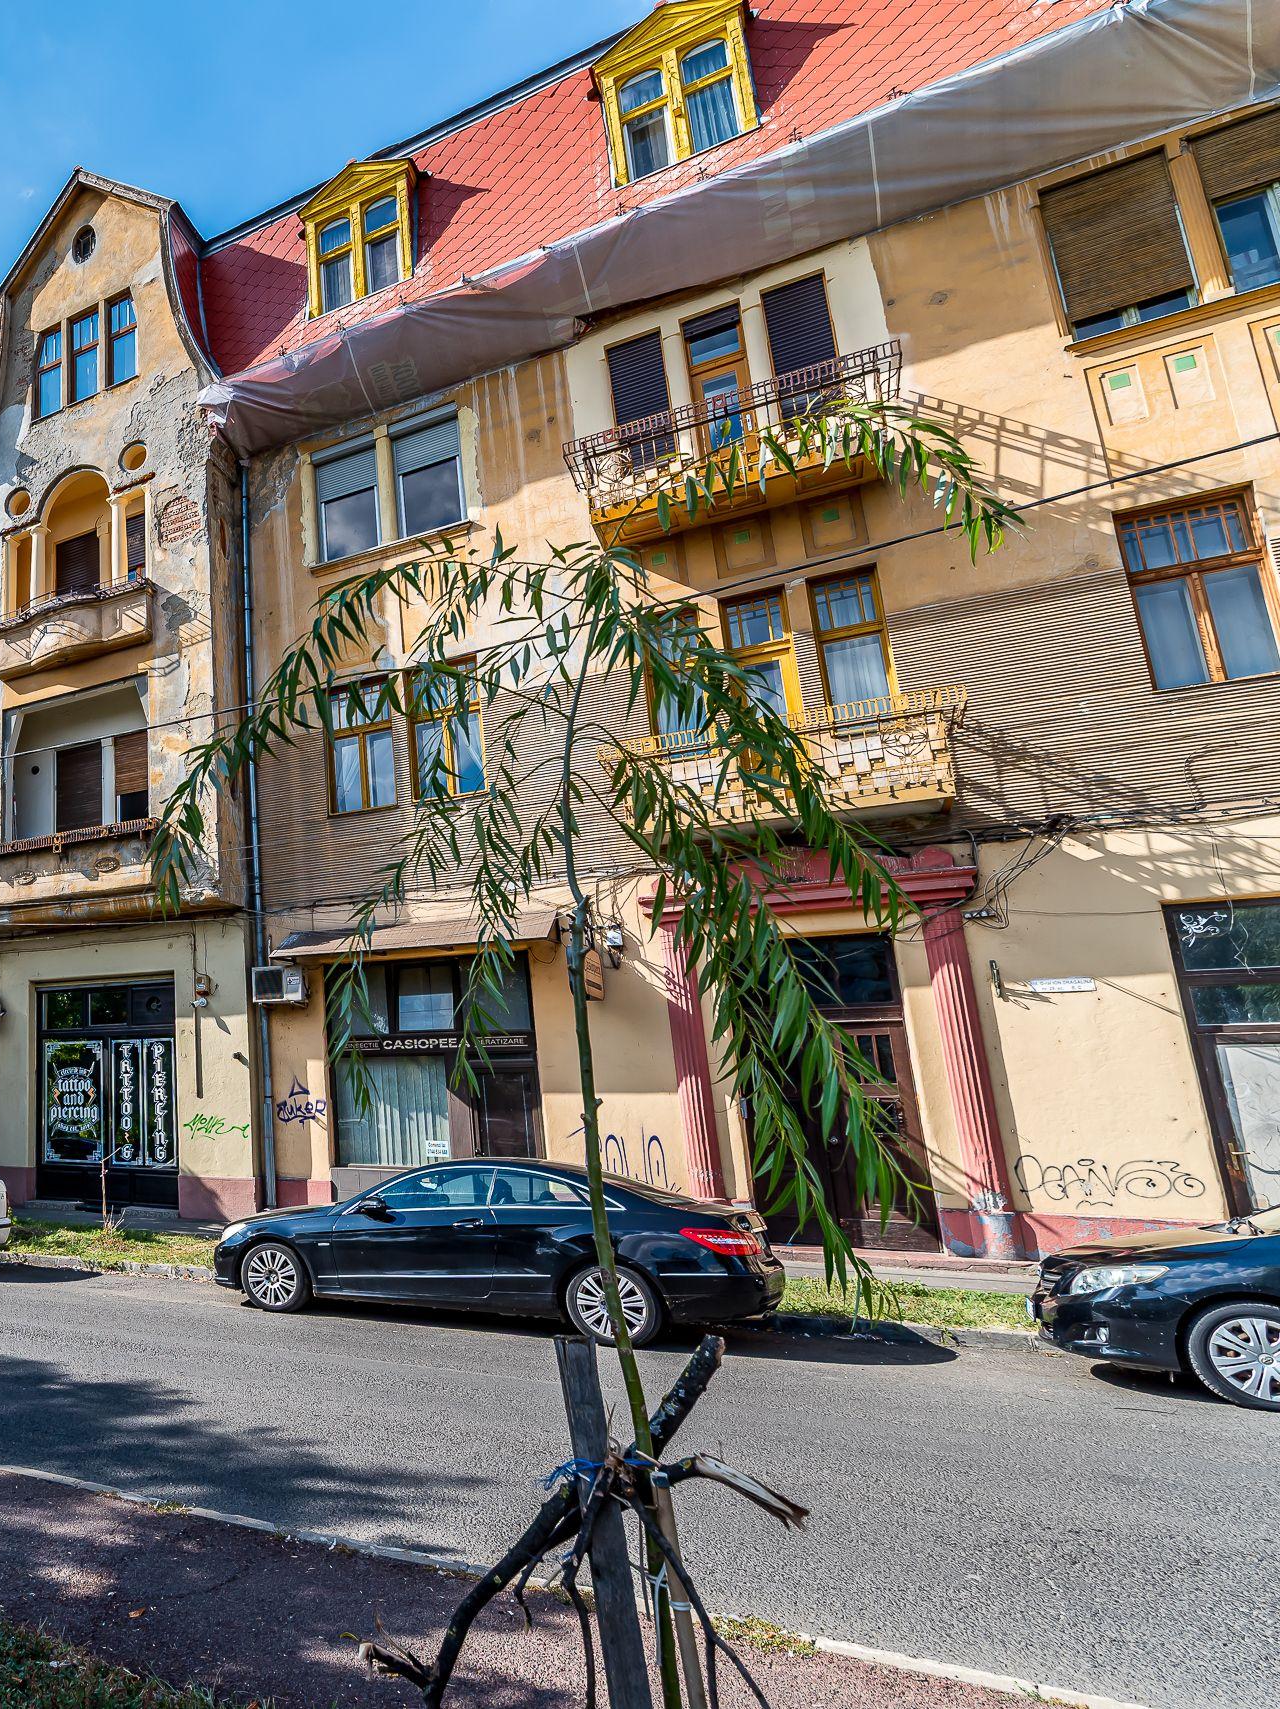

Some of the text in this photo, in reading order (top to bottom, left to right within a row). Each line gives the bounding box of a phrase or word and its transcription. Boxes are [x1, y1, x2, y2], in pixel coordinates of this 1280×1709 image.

[57, 1078, 91, 1092] tattoo
[119, 1043, 134, 1131] TATTOO
[63, 1092, 85, 1105] and
[50, 1105, 98, 1122] piercing
